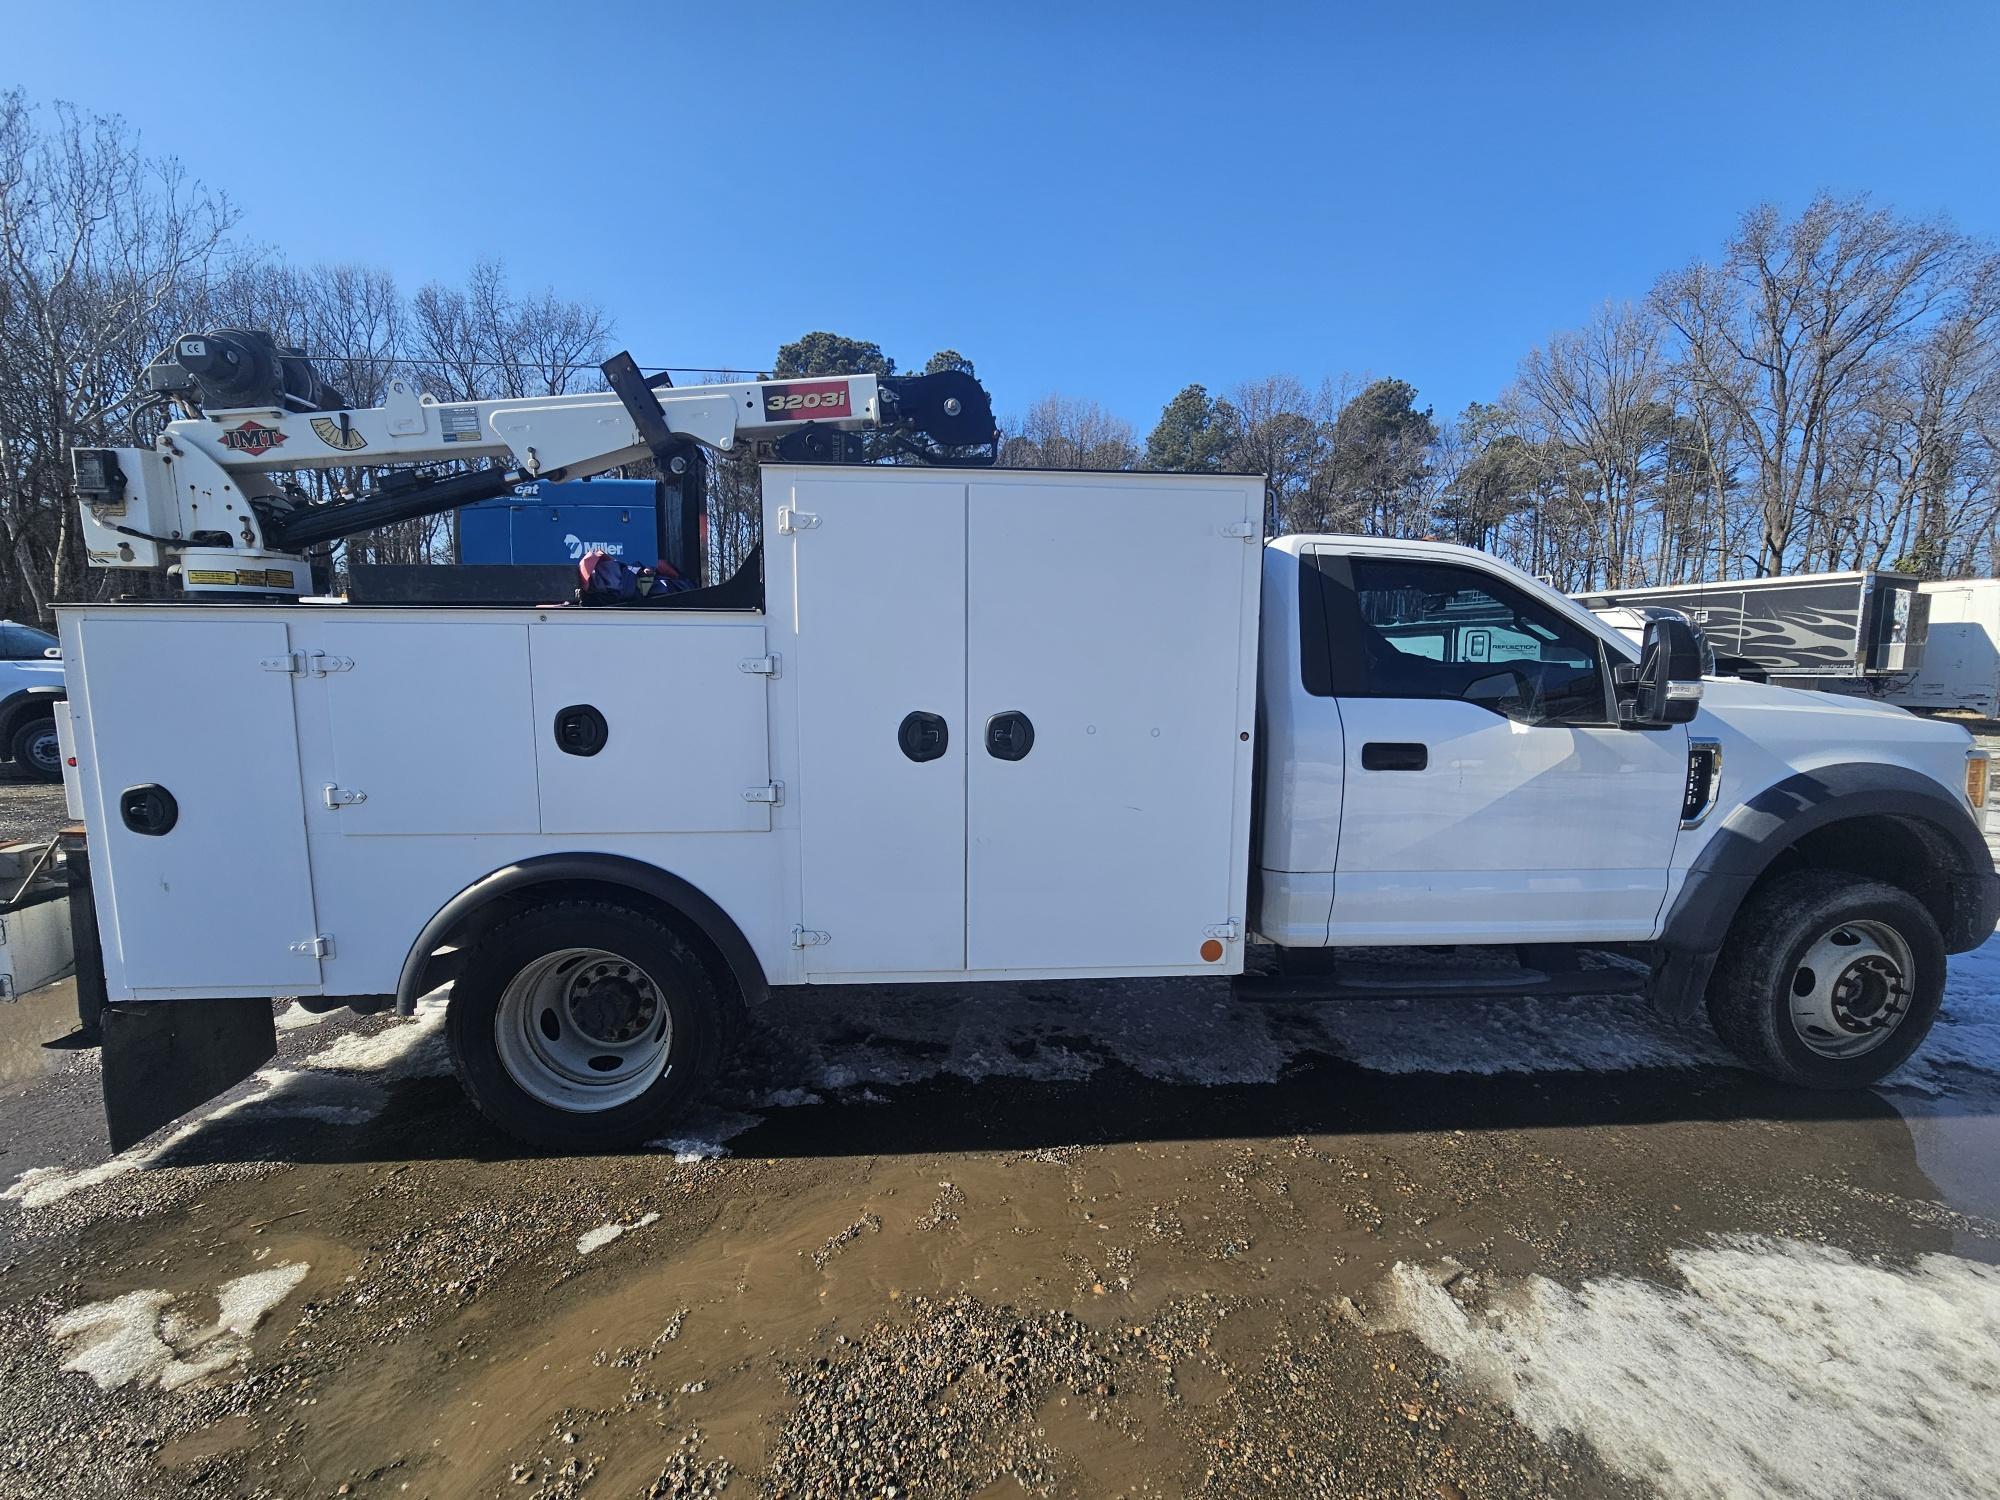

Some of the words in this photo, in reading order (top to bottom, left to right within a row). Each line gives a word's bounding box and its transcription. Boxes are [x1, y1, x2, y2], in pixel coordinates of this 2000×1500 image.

[187, 343, 200, 354] CE
[767, 390, 846, 411] 3203i
[225, 429, 280, 449] IMT
[514, 484, 540, 495] cat
